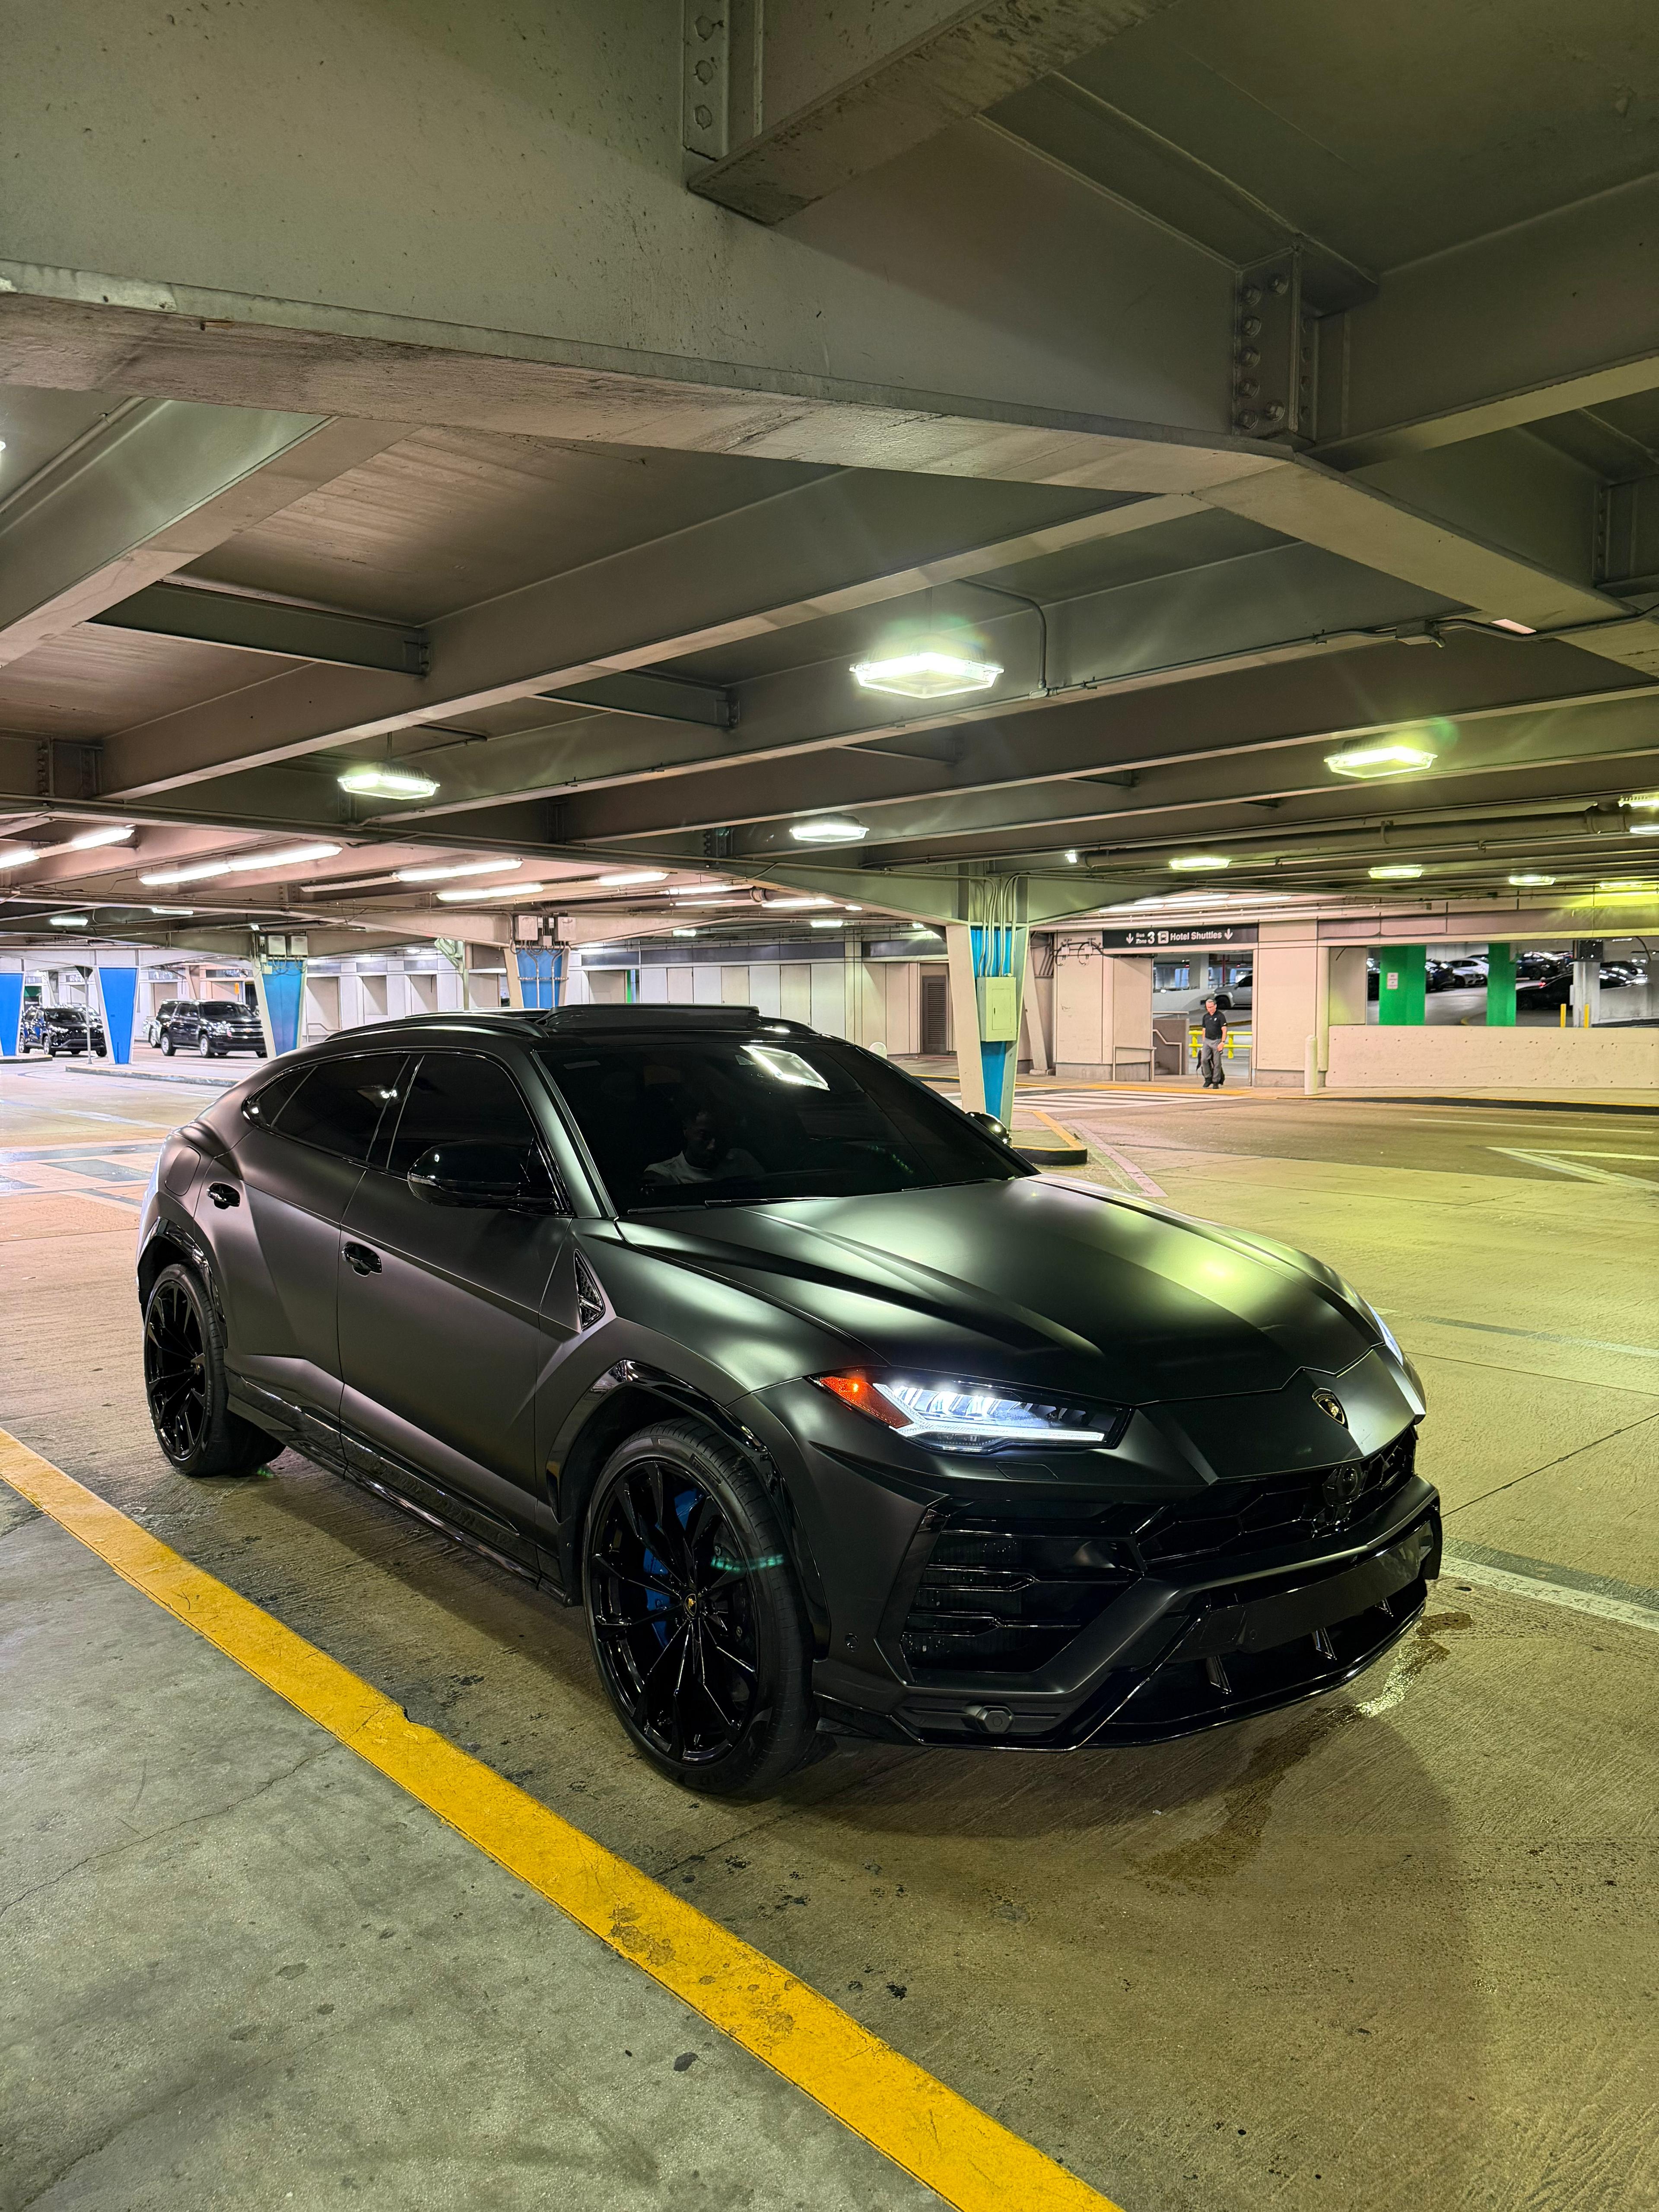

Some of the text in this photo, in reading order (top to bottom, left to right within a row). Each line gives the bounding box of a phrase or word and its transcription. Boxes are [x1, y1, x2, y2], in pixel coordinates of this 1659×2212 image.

[1147, 931, 1155, 944] 3
[1170, 931, 1222, 941] Hotel Shuttles
